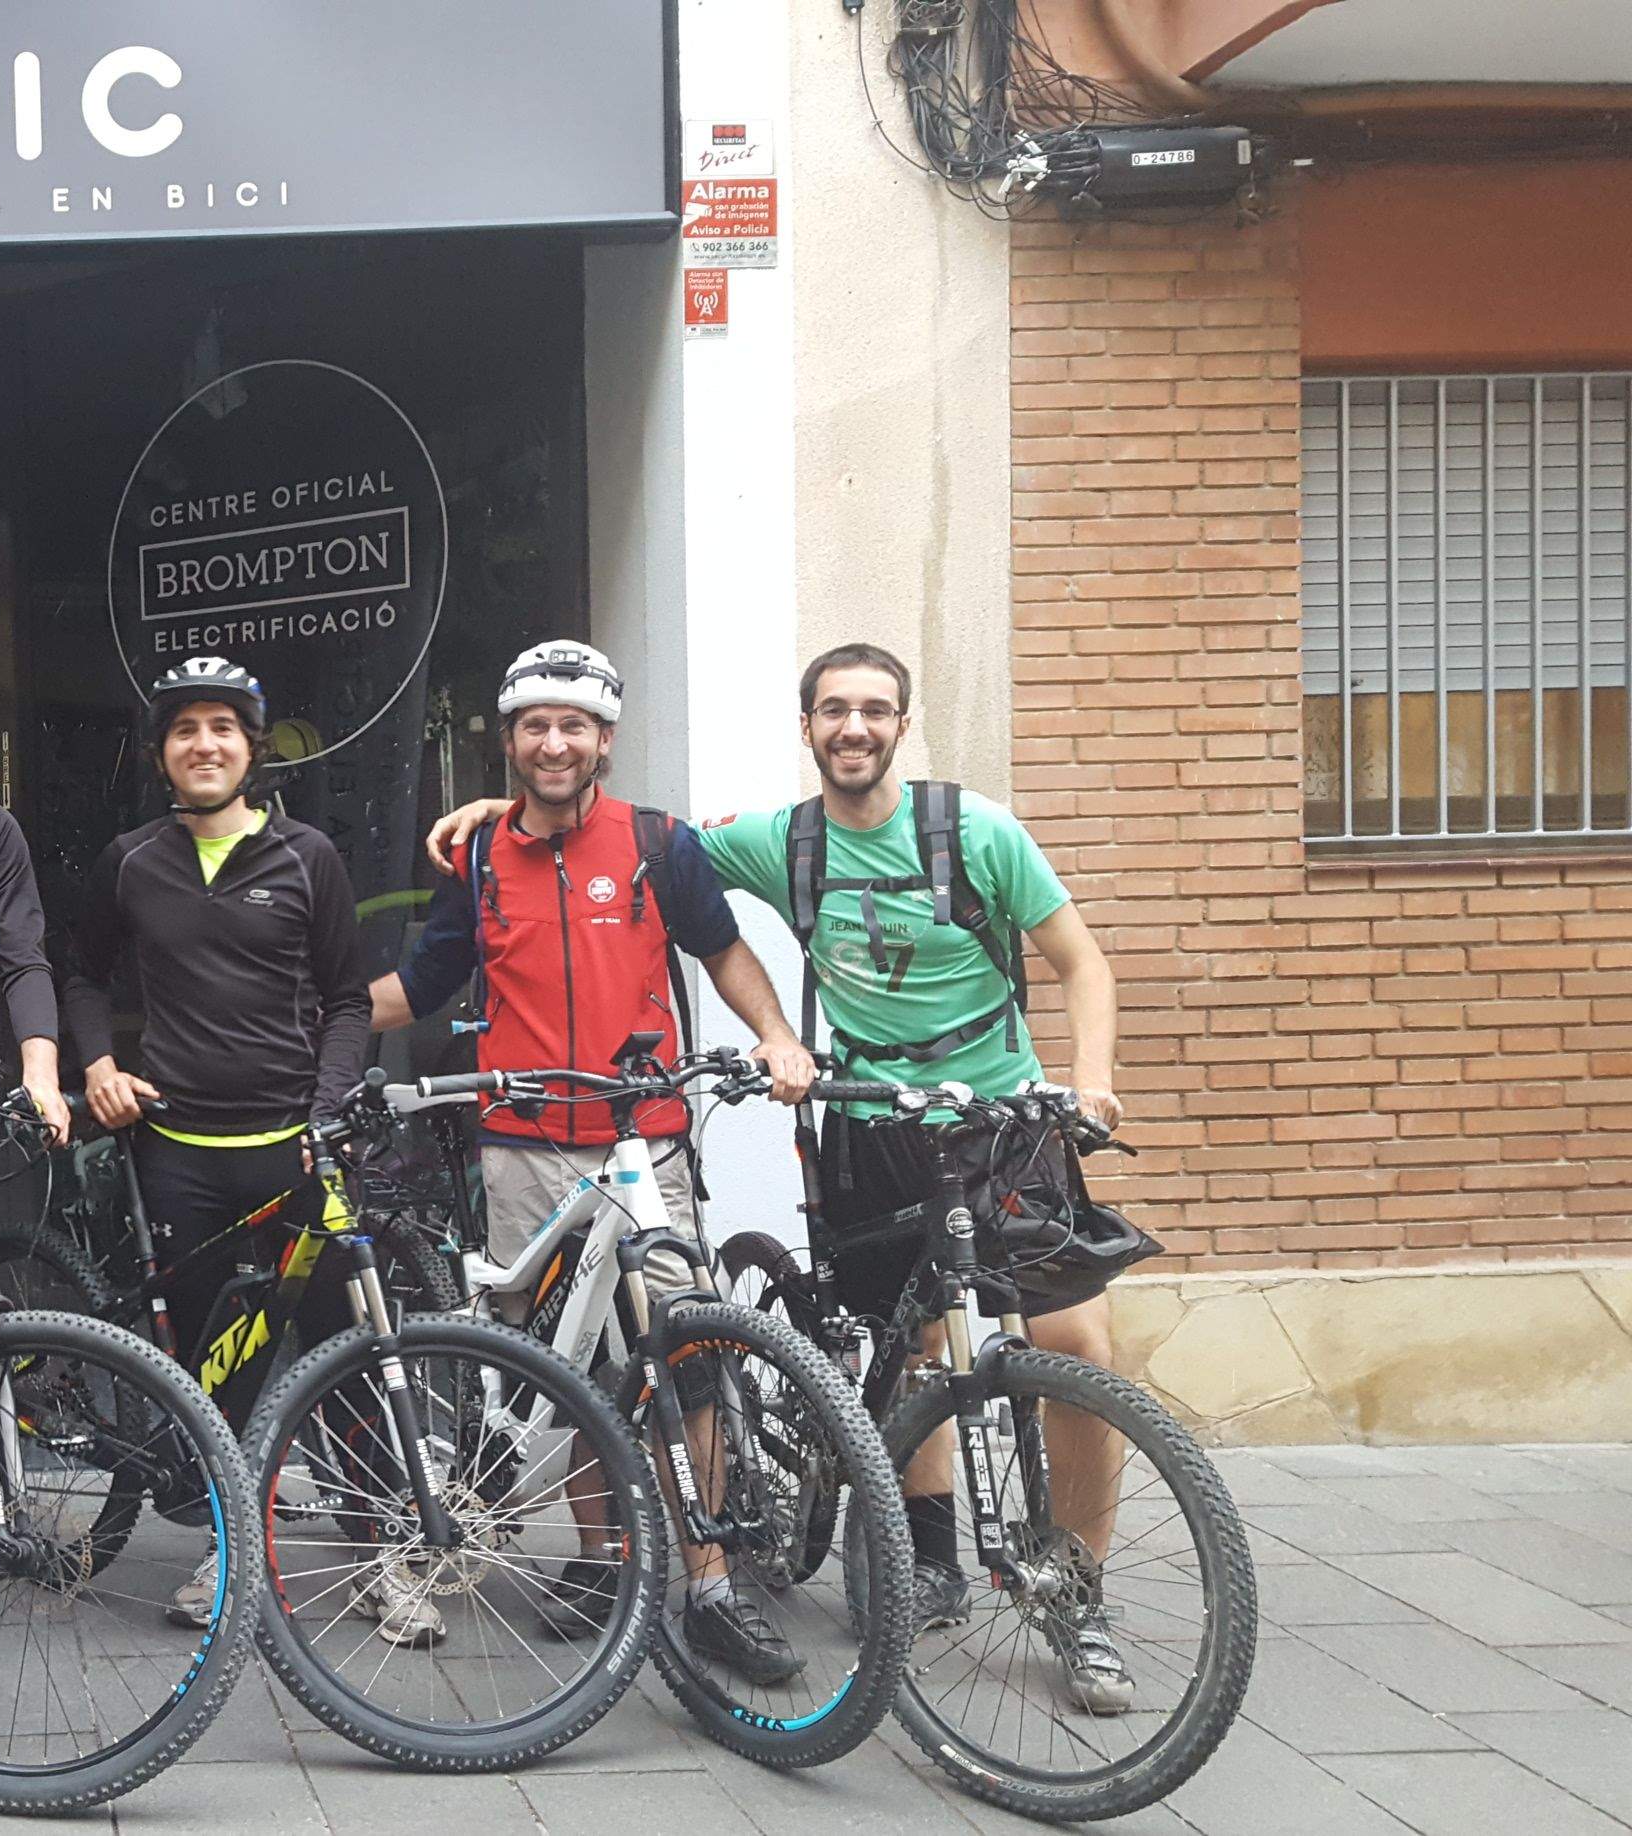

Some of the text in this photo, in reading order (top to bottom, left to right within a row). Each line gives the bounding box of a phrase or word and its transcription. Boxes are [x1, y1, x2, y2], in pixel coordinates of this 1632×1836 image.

[52, 187, 112, 211] EN
[167, 182, 289, 208] BICI
[690, 182, 770, 200] Alarma
[690, 225, 721, 235] Aviso
[723, 226, 731, 234] a
[715, 210, 726, 219] de
[702, 241, 769, 252] 902 366 366
[150, 470, 394, 528] CENTRE OFICIAL
[156, 532, 389, 598] BROMPTON
[154, 599, 397, 653] ELECTRIFICACIÓ
[828, 921, 862, 933] JEAN
[200, 1309, 271, 1397] KTM
[968, 1426, 996, 1516] REBA
[606, 1509, 653, 1676] SMART SAM
